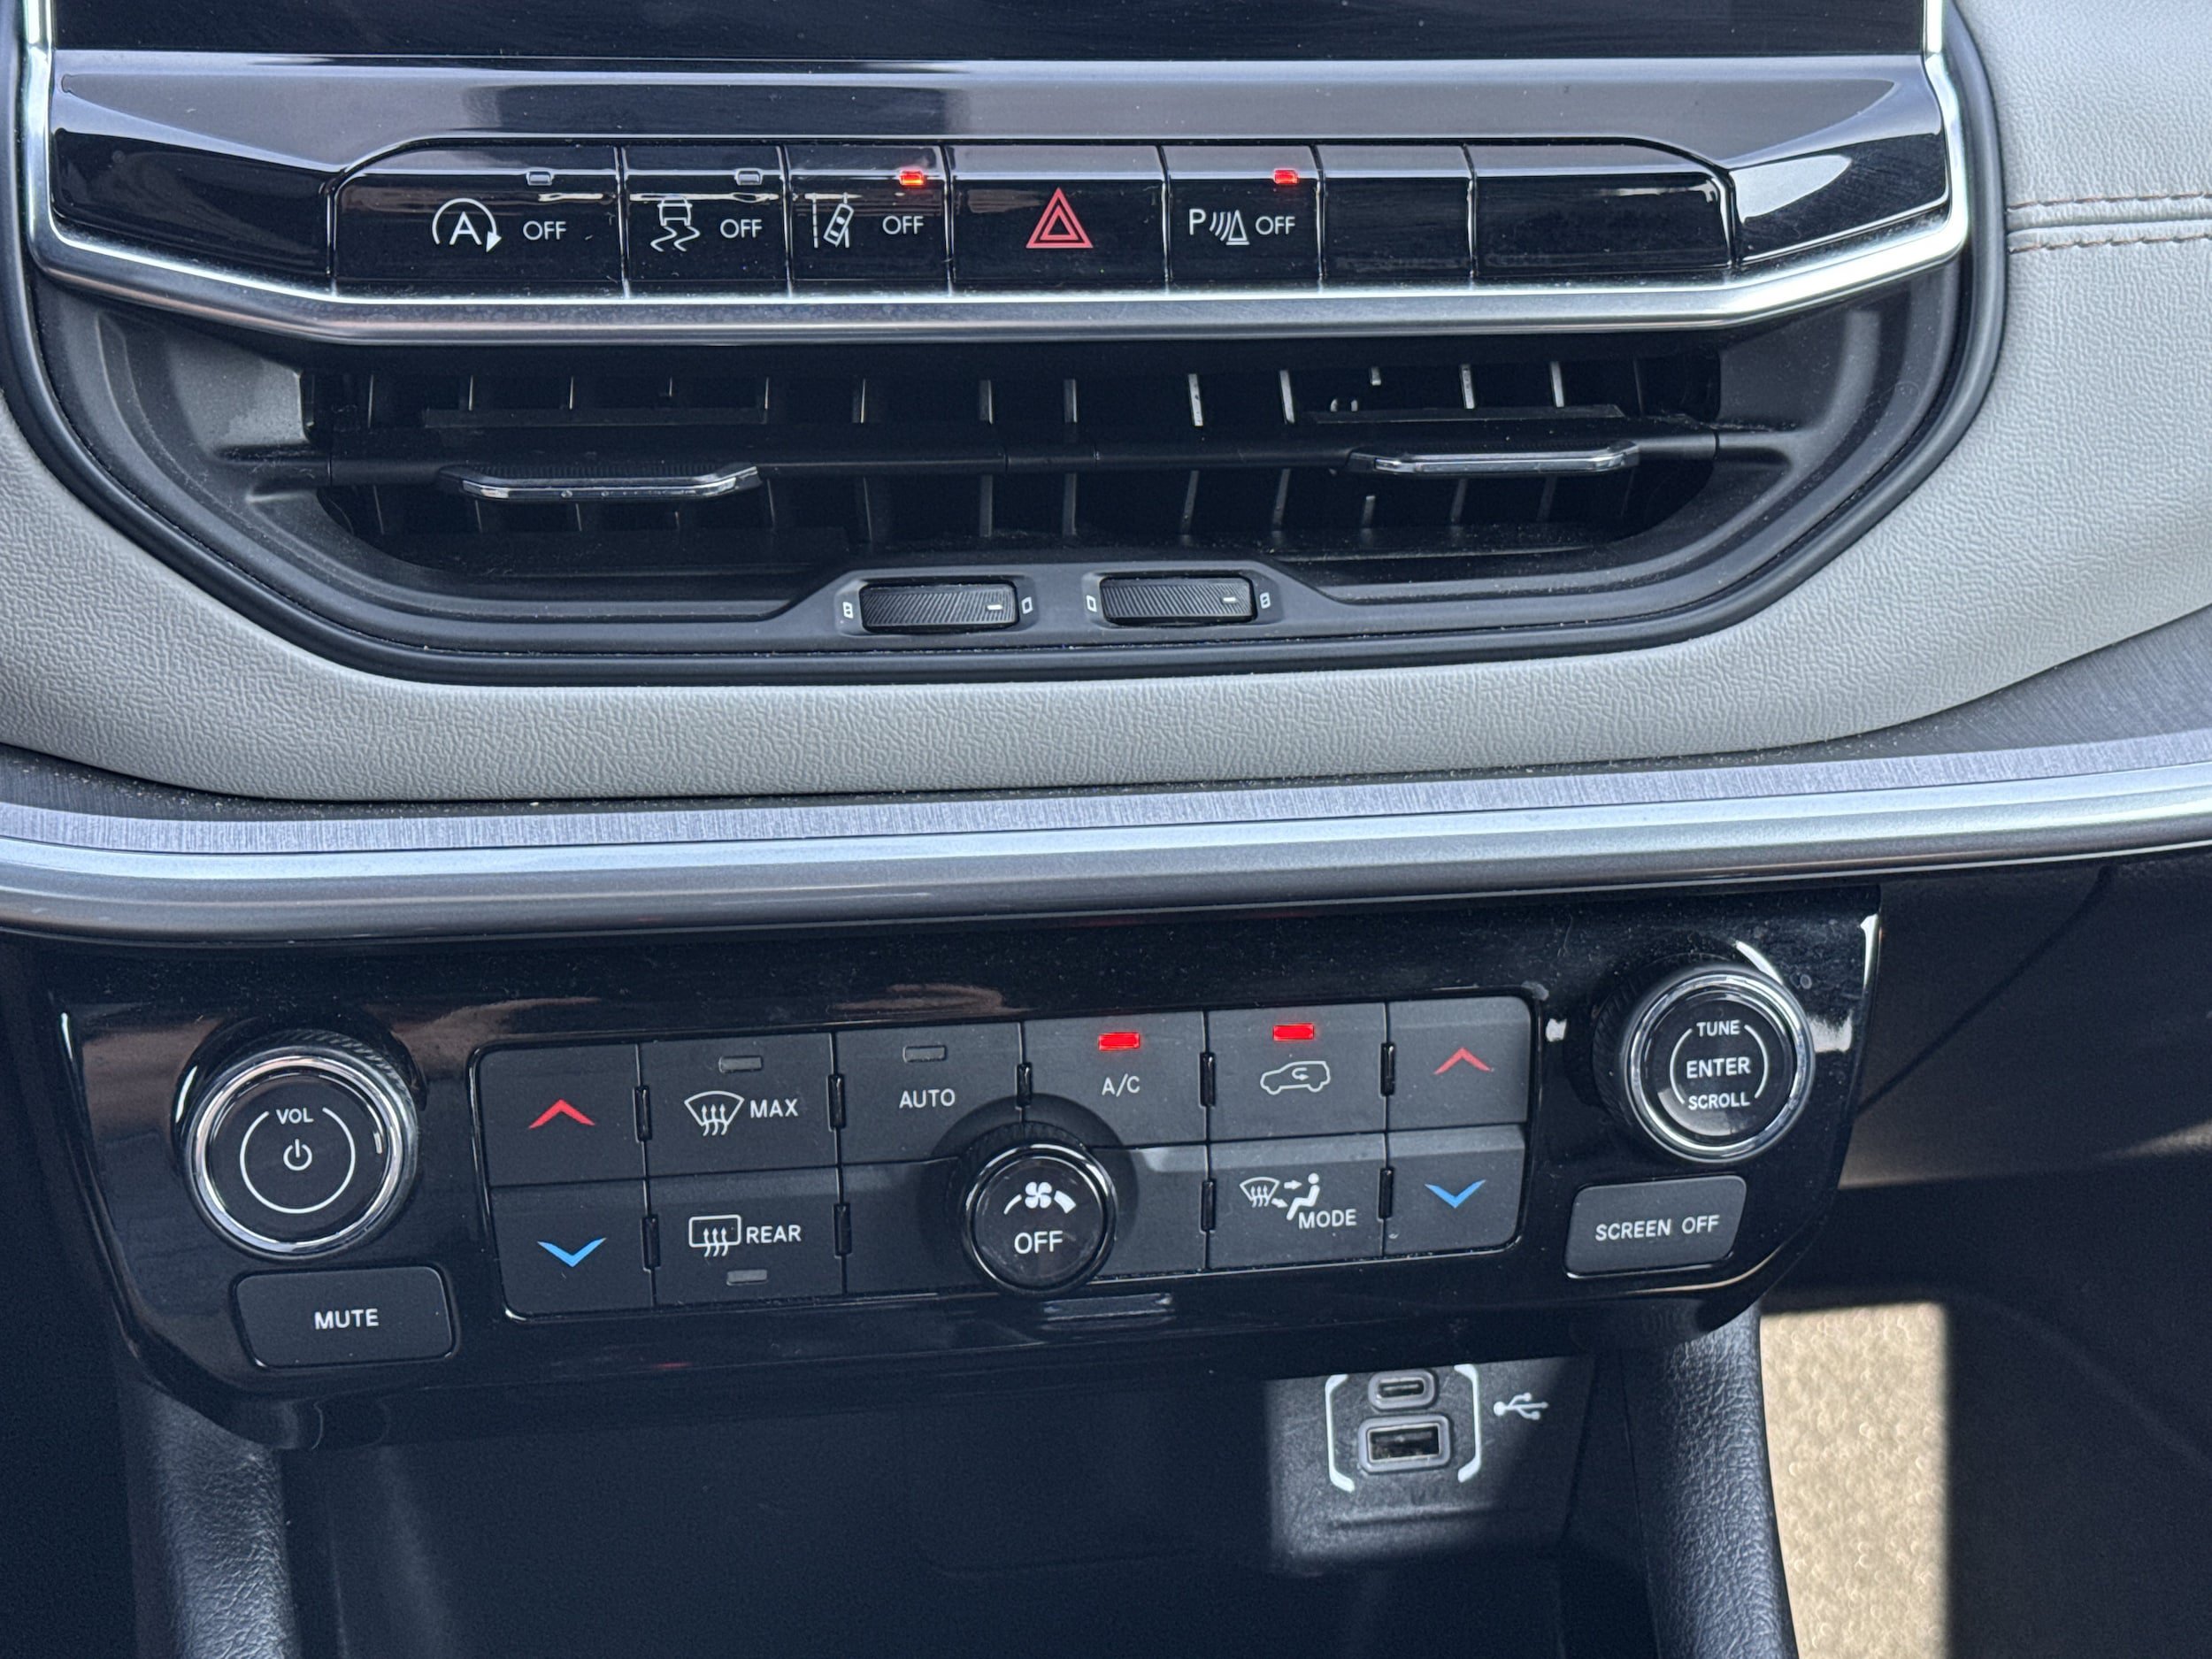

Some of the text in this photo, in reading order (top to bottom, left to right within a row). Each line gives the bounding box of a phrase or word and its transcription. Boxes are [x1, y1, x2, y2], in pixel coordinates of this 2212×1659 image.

[449, 211, 567, 245] A OFF
[719, 219, 763, 239] OFF
[882, 215, 924, 235] OFF
[1188, 208, 1295, 235] P OFF
[1696, 1019, 1740, 1037] TUNE
[1686, 1056, 1751, 1079] ENTER
[1102, 1073, 1141, 1097] A/C
[749, 1098, 798, 1118] MAX
[899, 1087, 956, 1109] AUTO
[1687, 1092, 1750, 1111] SCROLL
[275, 1107, 314, 1125] VOL
[1298, 1209, 1356, 1229] MODE
[1595, 1214, 1720, 1241] SCREEN OFF
[746, 1224, 802, 1244] REAR
[1014, 1230, 1064, 1255] OFF
[314, 1308, 380, 1330] MUTE
